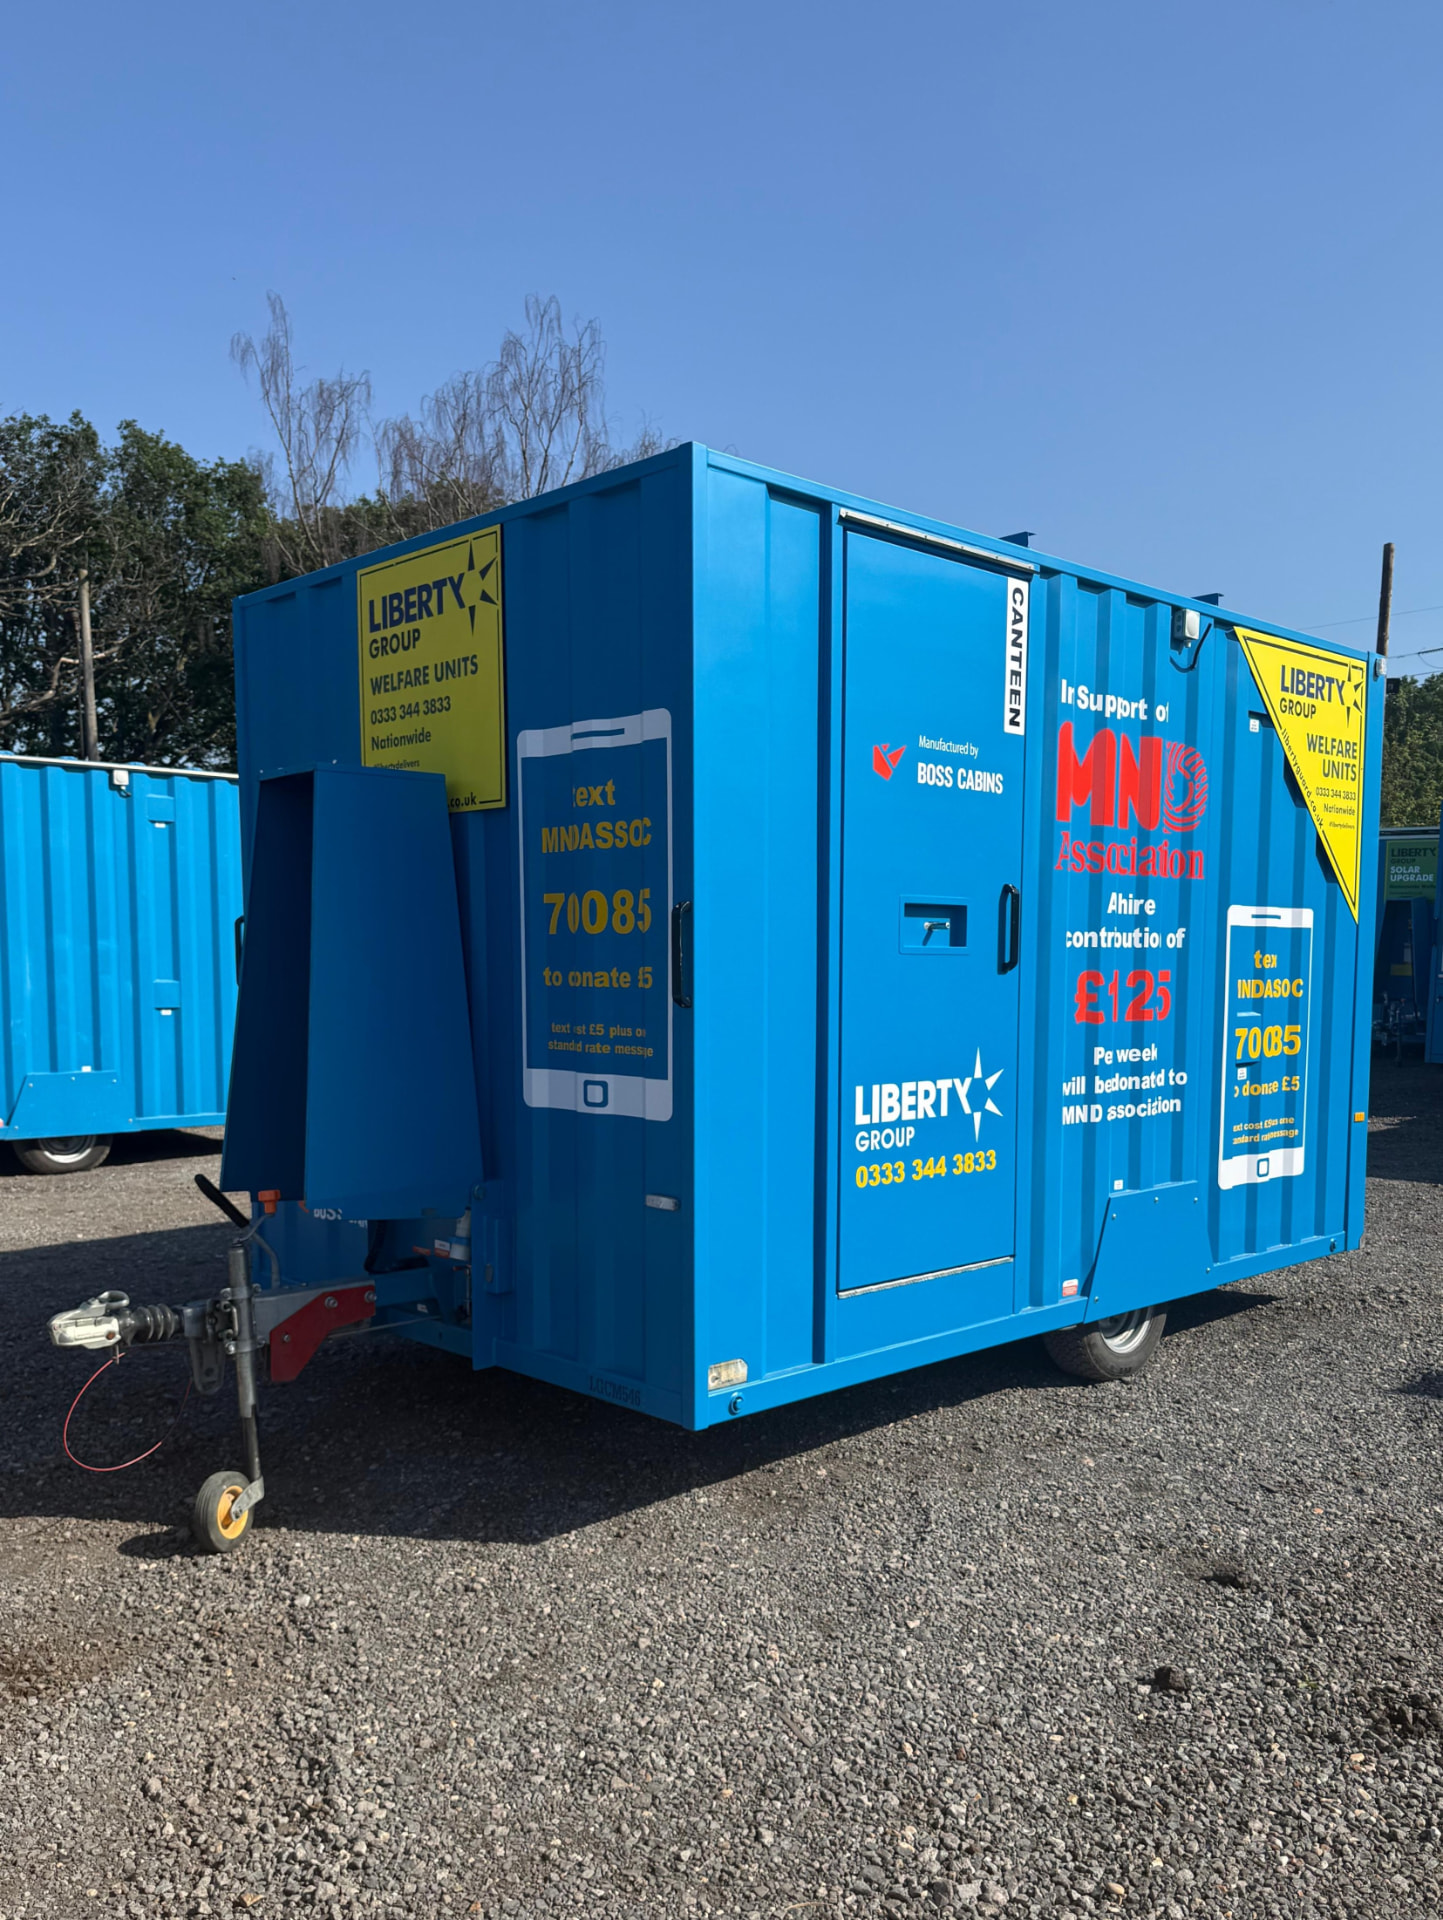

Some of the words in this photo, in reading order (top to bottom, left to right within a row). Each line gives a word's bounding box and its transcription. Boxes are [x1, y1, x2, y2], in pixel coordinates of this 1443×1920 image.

[368, 572, 466, 634] LIBERTY
[369, 628, 421, 659] GROUP
[1008, 587, 1024, 728] CANTEEN
[370, 665, 430, 696] WELFARE
[434, 654, 479, 683] UNITS
[1280, 664, 1346, 706] LIBERTY
[371, 706, 397, 725] 0333
[399, 702, 420, 720] 344
[423, 696, 452, 716] 3833
[1279, 697, 1317, 720] GROUP
[371, 727, 432, 751] Nationwide
[918, 734, 969, 755] Manufactured
[969, 745, 979, 759] by
[1306, 732, 1358, 760] WELFARE
[917, 761, 954, 788] BOSS
[957, 767, 1004, 795] CABINS
[1055, 720, 1208, 834] MND
[1281, 728, 1324, 830] libertyguard.co.uk
[1322, 758, 1357, 782] UNITS
[1315, 786, 1330, 798] 0333
[1330, 788, 1342, 799] 344
[1342, 789, 1356, 801] 3833
[1323, 803, 1356, 816] Nationwide
[1391, 847, 1437, 858] LIBERTY
[1390, 866, 1420, 874] SOLAR
[1390, 874, 1434, 882] UPGRADE
[543, 888, 652, 935] 70085
[1166, 927, 1187, 949] of
[543, 966, 563, 987] to
[1074, 969, 1172, 1025] £125
[551, 1022, 571, 1034] text
[589, 1023, 605, 1036] £5
[609, 1024, 633, 1038] plus
[1234, 1025, 1302, 1060] 70085
[585, 1042, 611, 1054] rate
[1168, 1067, 1188, 1086] to
[1281, 1075, 1300, 1092] £5
[855, 1077, 972, 1126] LIBERTY
[1062, 1104, 1103, 1126] MND
[855, 1126, 915, 1152] GROUP
[855, 1161, 905, 1189] 0333
[912, 1155, 947, 1181] 344
[953, 1149, 997, 1175] 3833
